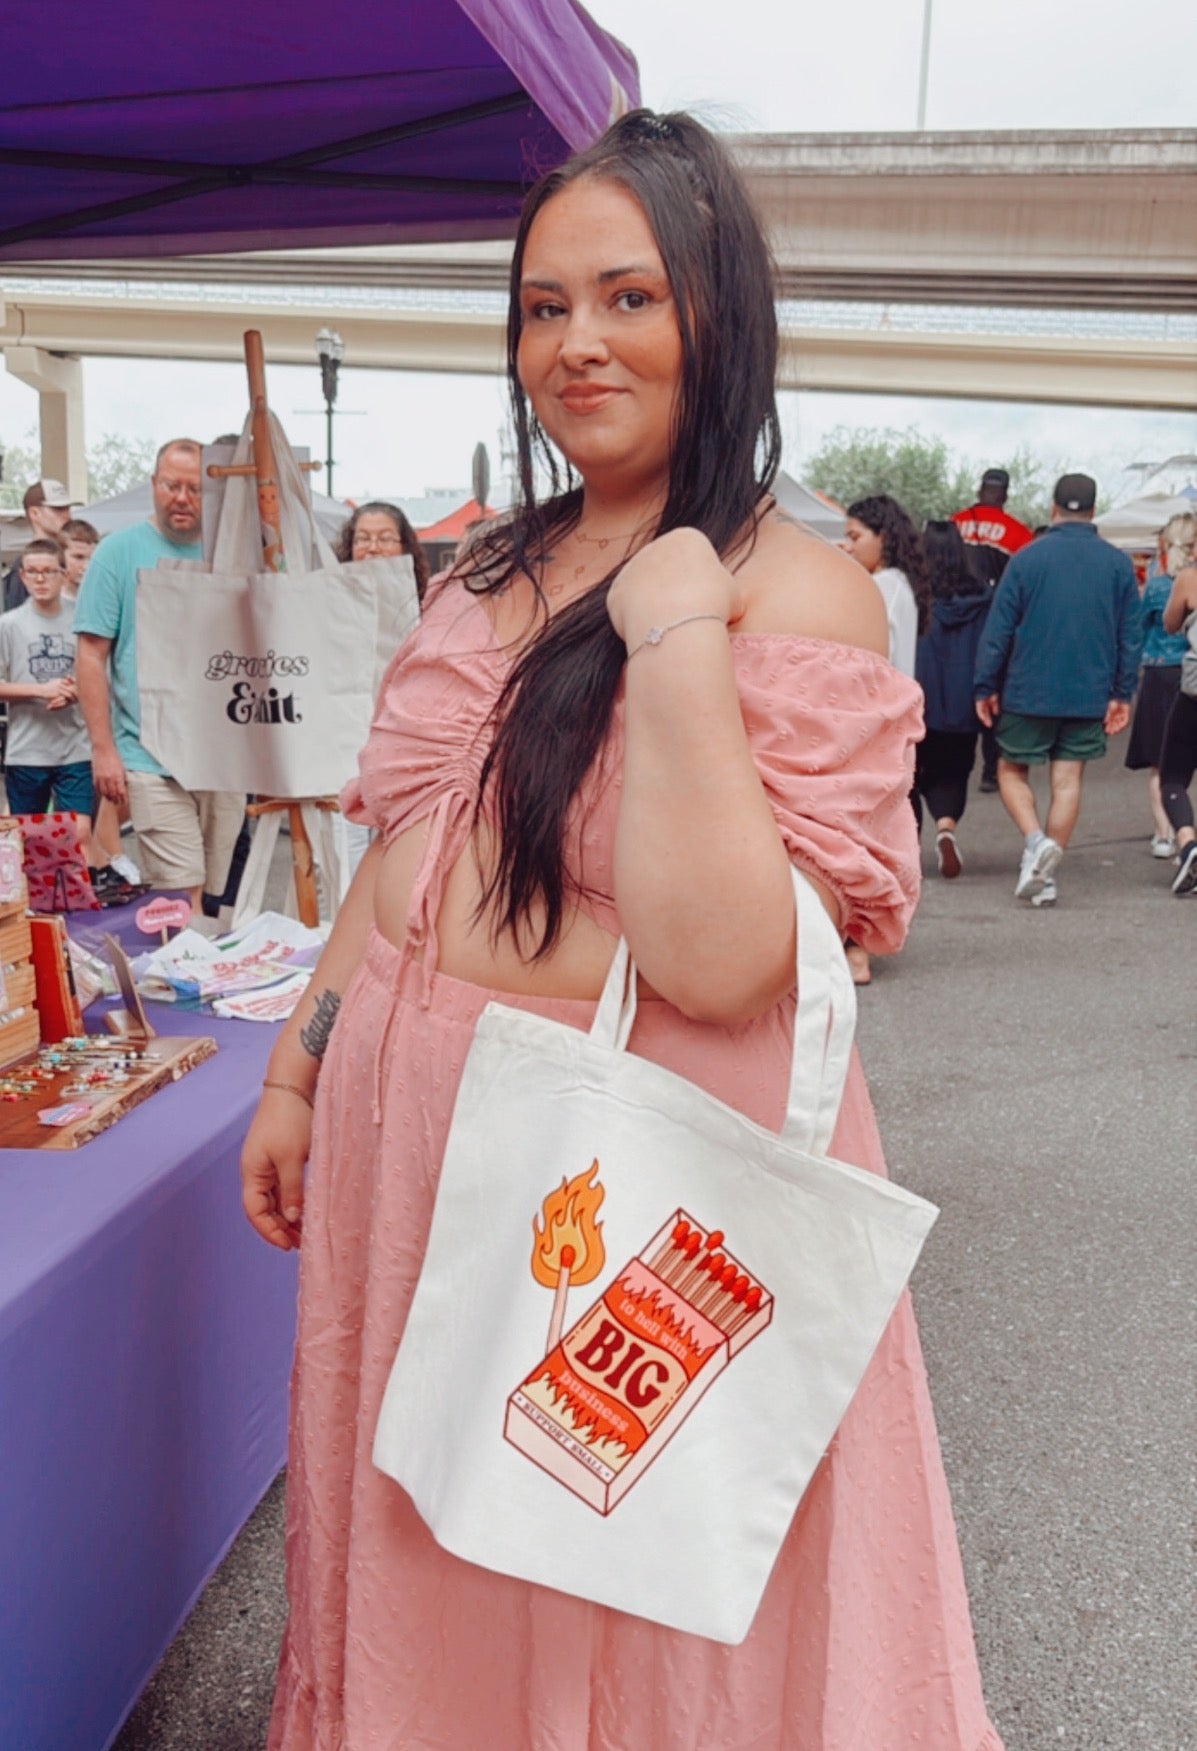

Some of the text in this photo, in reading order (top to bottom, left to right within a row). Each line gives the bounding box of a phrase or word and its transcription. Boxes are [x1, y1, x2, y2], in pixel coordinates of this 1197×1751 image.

[619, 1298, 688, 1361] to hell with
[574, 1319, 669, 1408] BIG
[559, 1369, 629, 1432] business
[523, 1402, 604, 1474] SUPPORT SMALL
